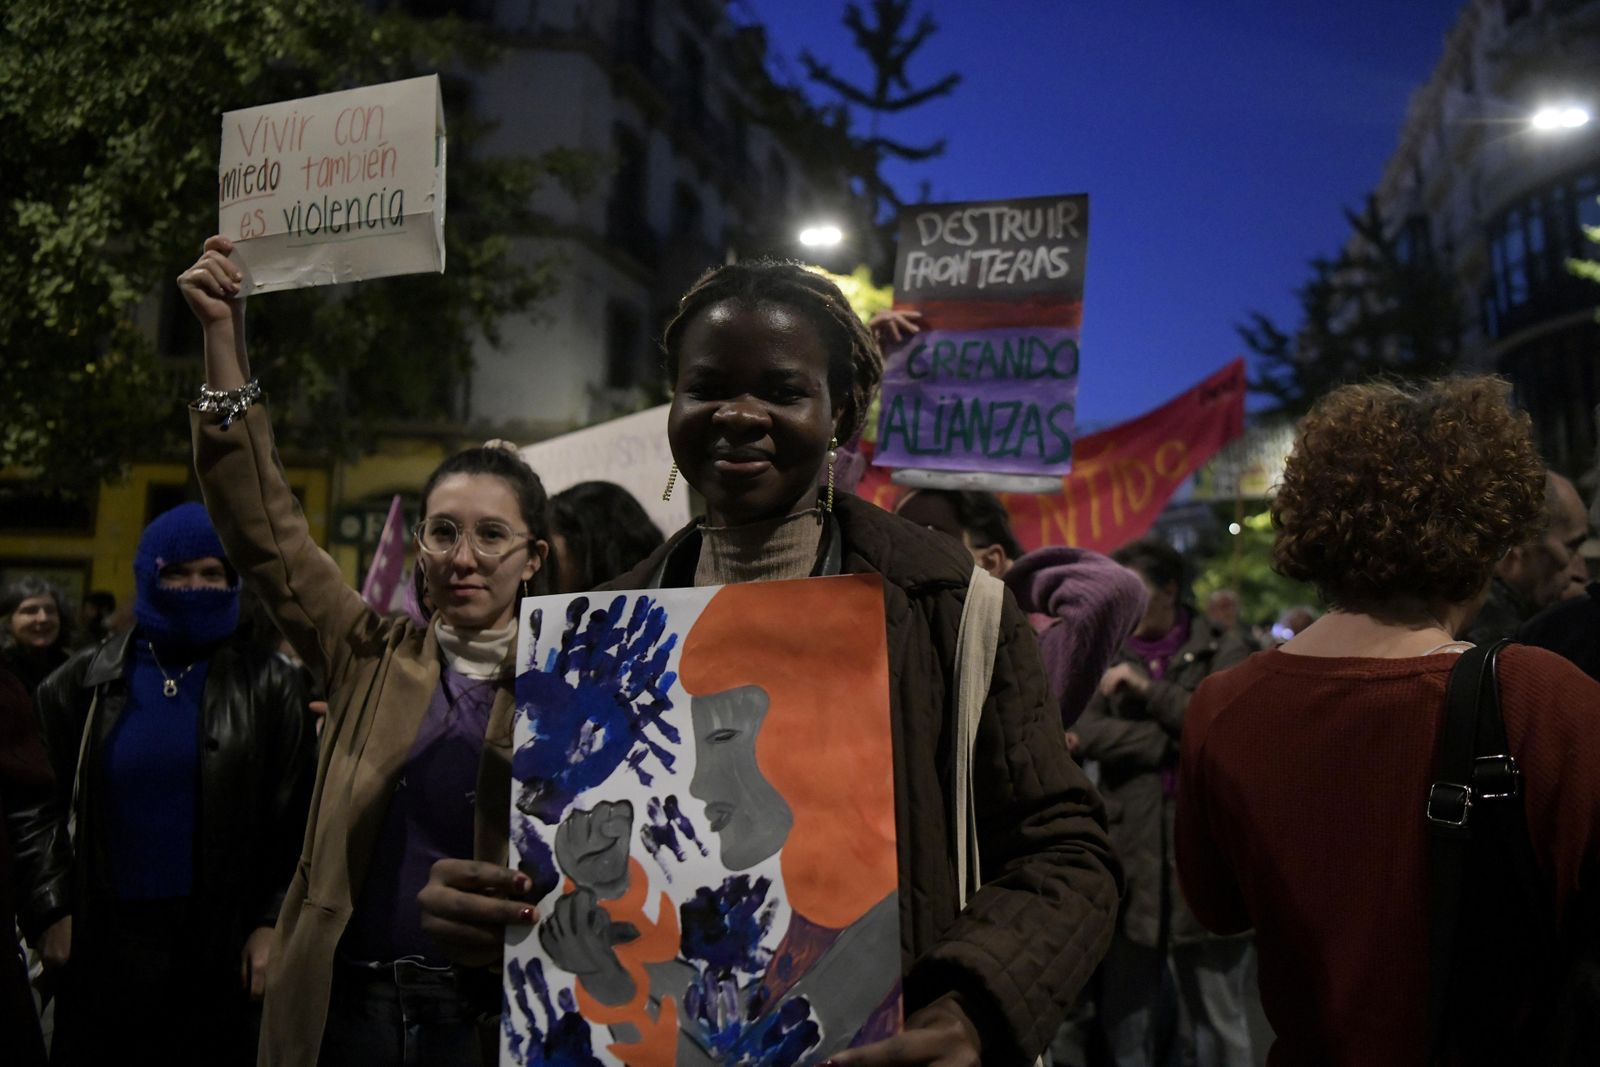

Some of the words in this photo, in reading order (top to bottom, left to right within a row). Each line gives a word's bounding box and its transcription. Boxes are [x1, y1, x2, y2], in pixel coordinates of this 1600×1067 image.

[237, 111, 314, 157] Vivir
[334, 104, 384, 146] con
[221, 157, 281, 201] miedo
[301, 140, 398, 191] también
[239, 207, 266, 239] es
[283, 187, 404, 238] violencia
[915, 201, 1080, 247] DESTRUIR
[903, 246, 1070, 292] FRONTERAS
[907, 336, 1079, 379] CREANDO
